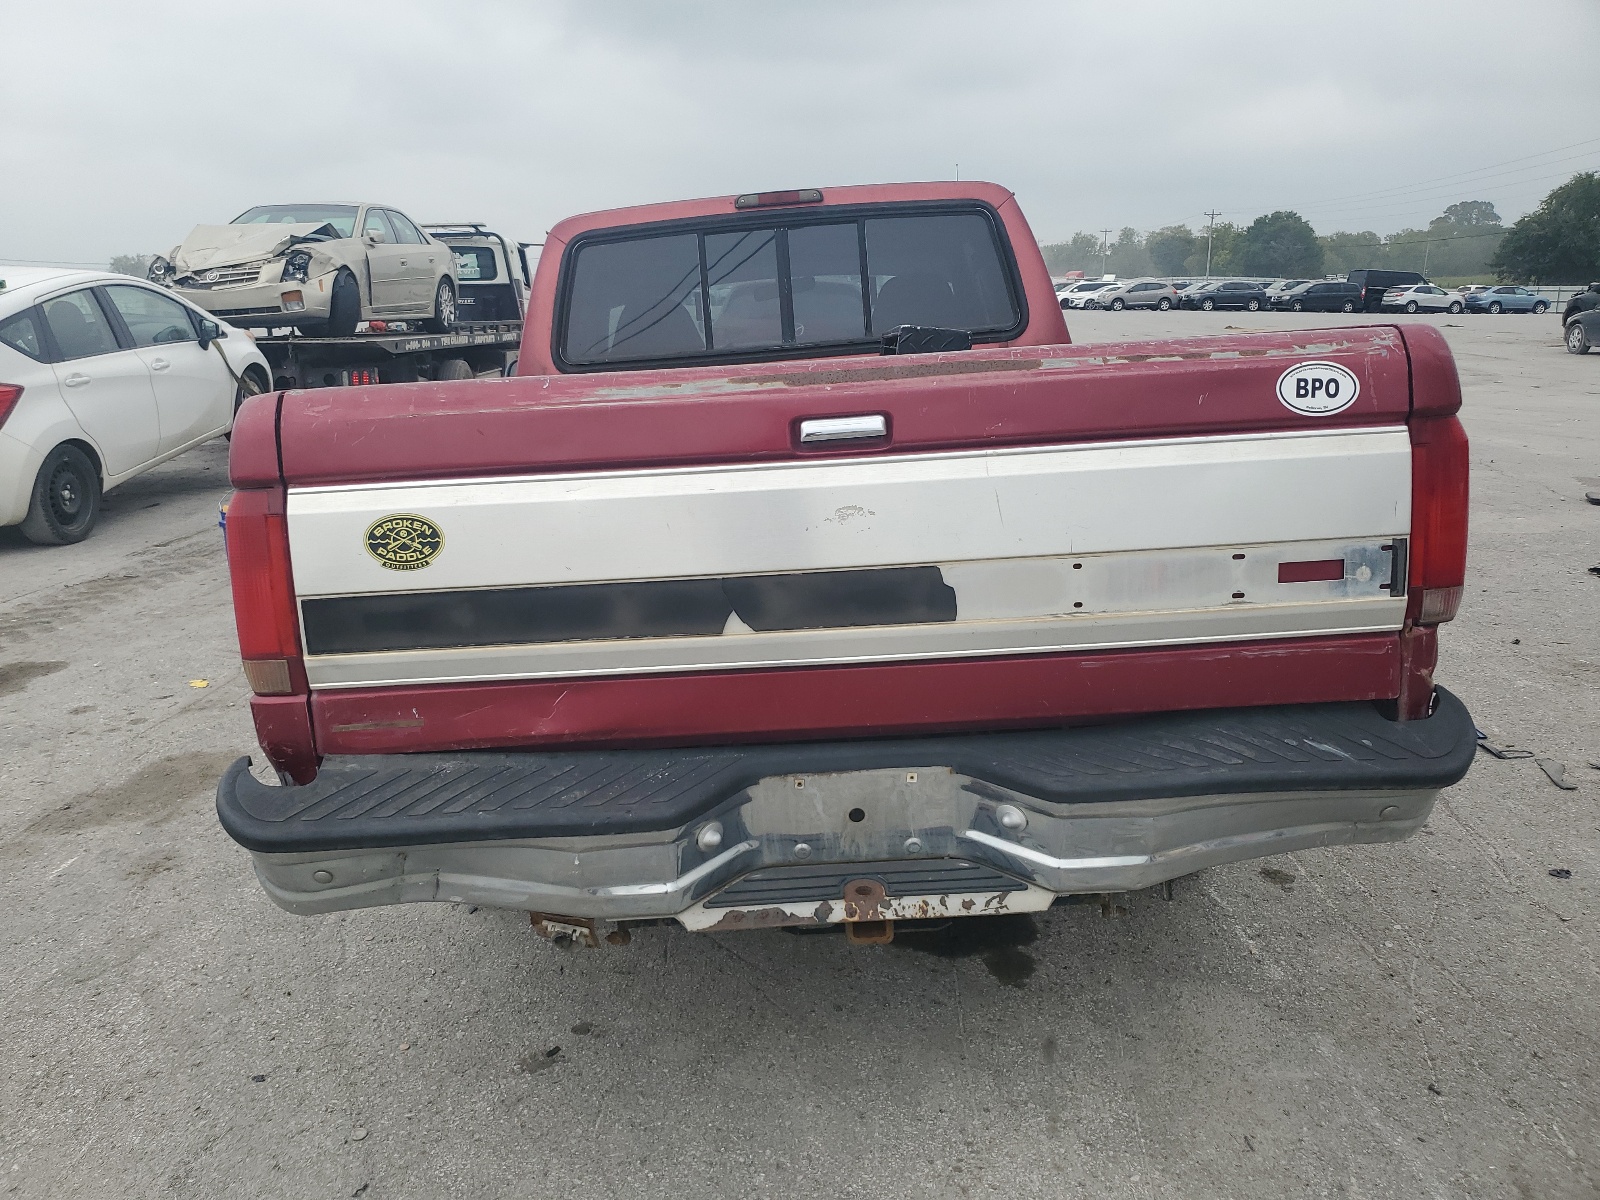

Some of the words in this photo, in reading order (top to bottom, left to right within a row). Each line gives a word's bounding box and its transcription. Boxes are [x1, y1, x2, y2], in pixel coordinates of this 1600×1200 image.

[1296, 378, 1339, 398] BPO
[374, 520, 432, 537] BROKEN
[377, 546, 433, 561] PADDLE
